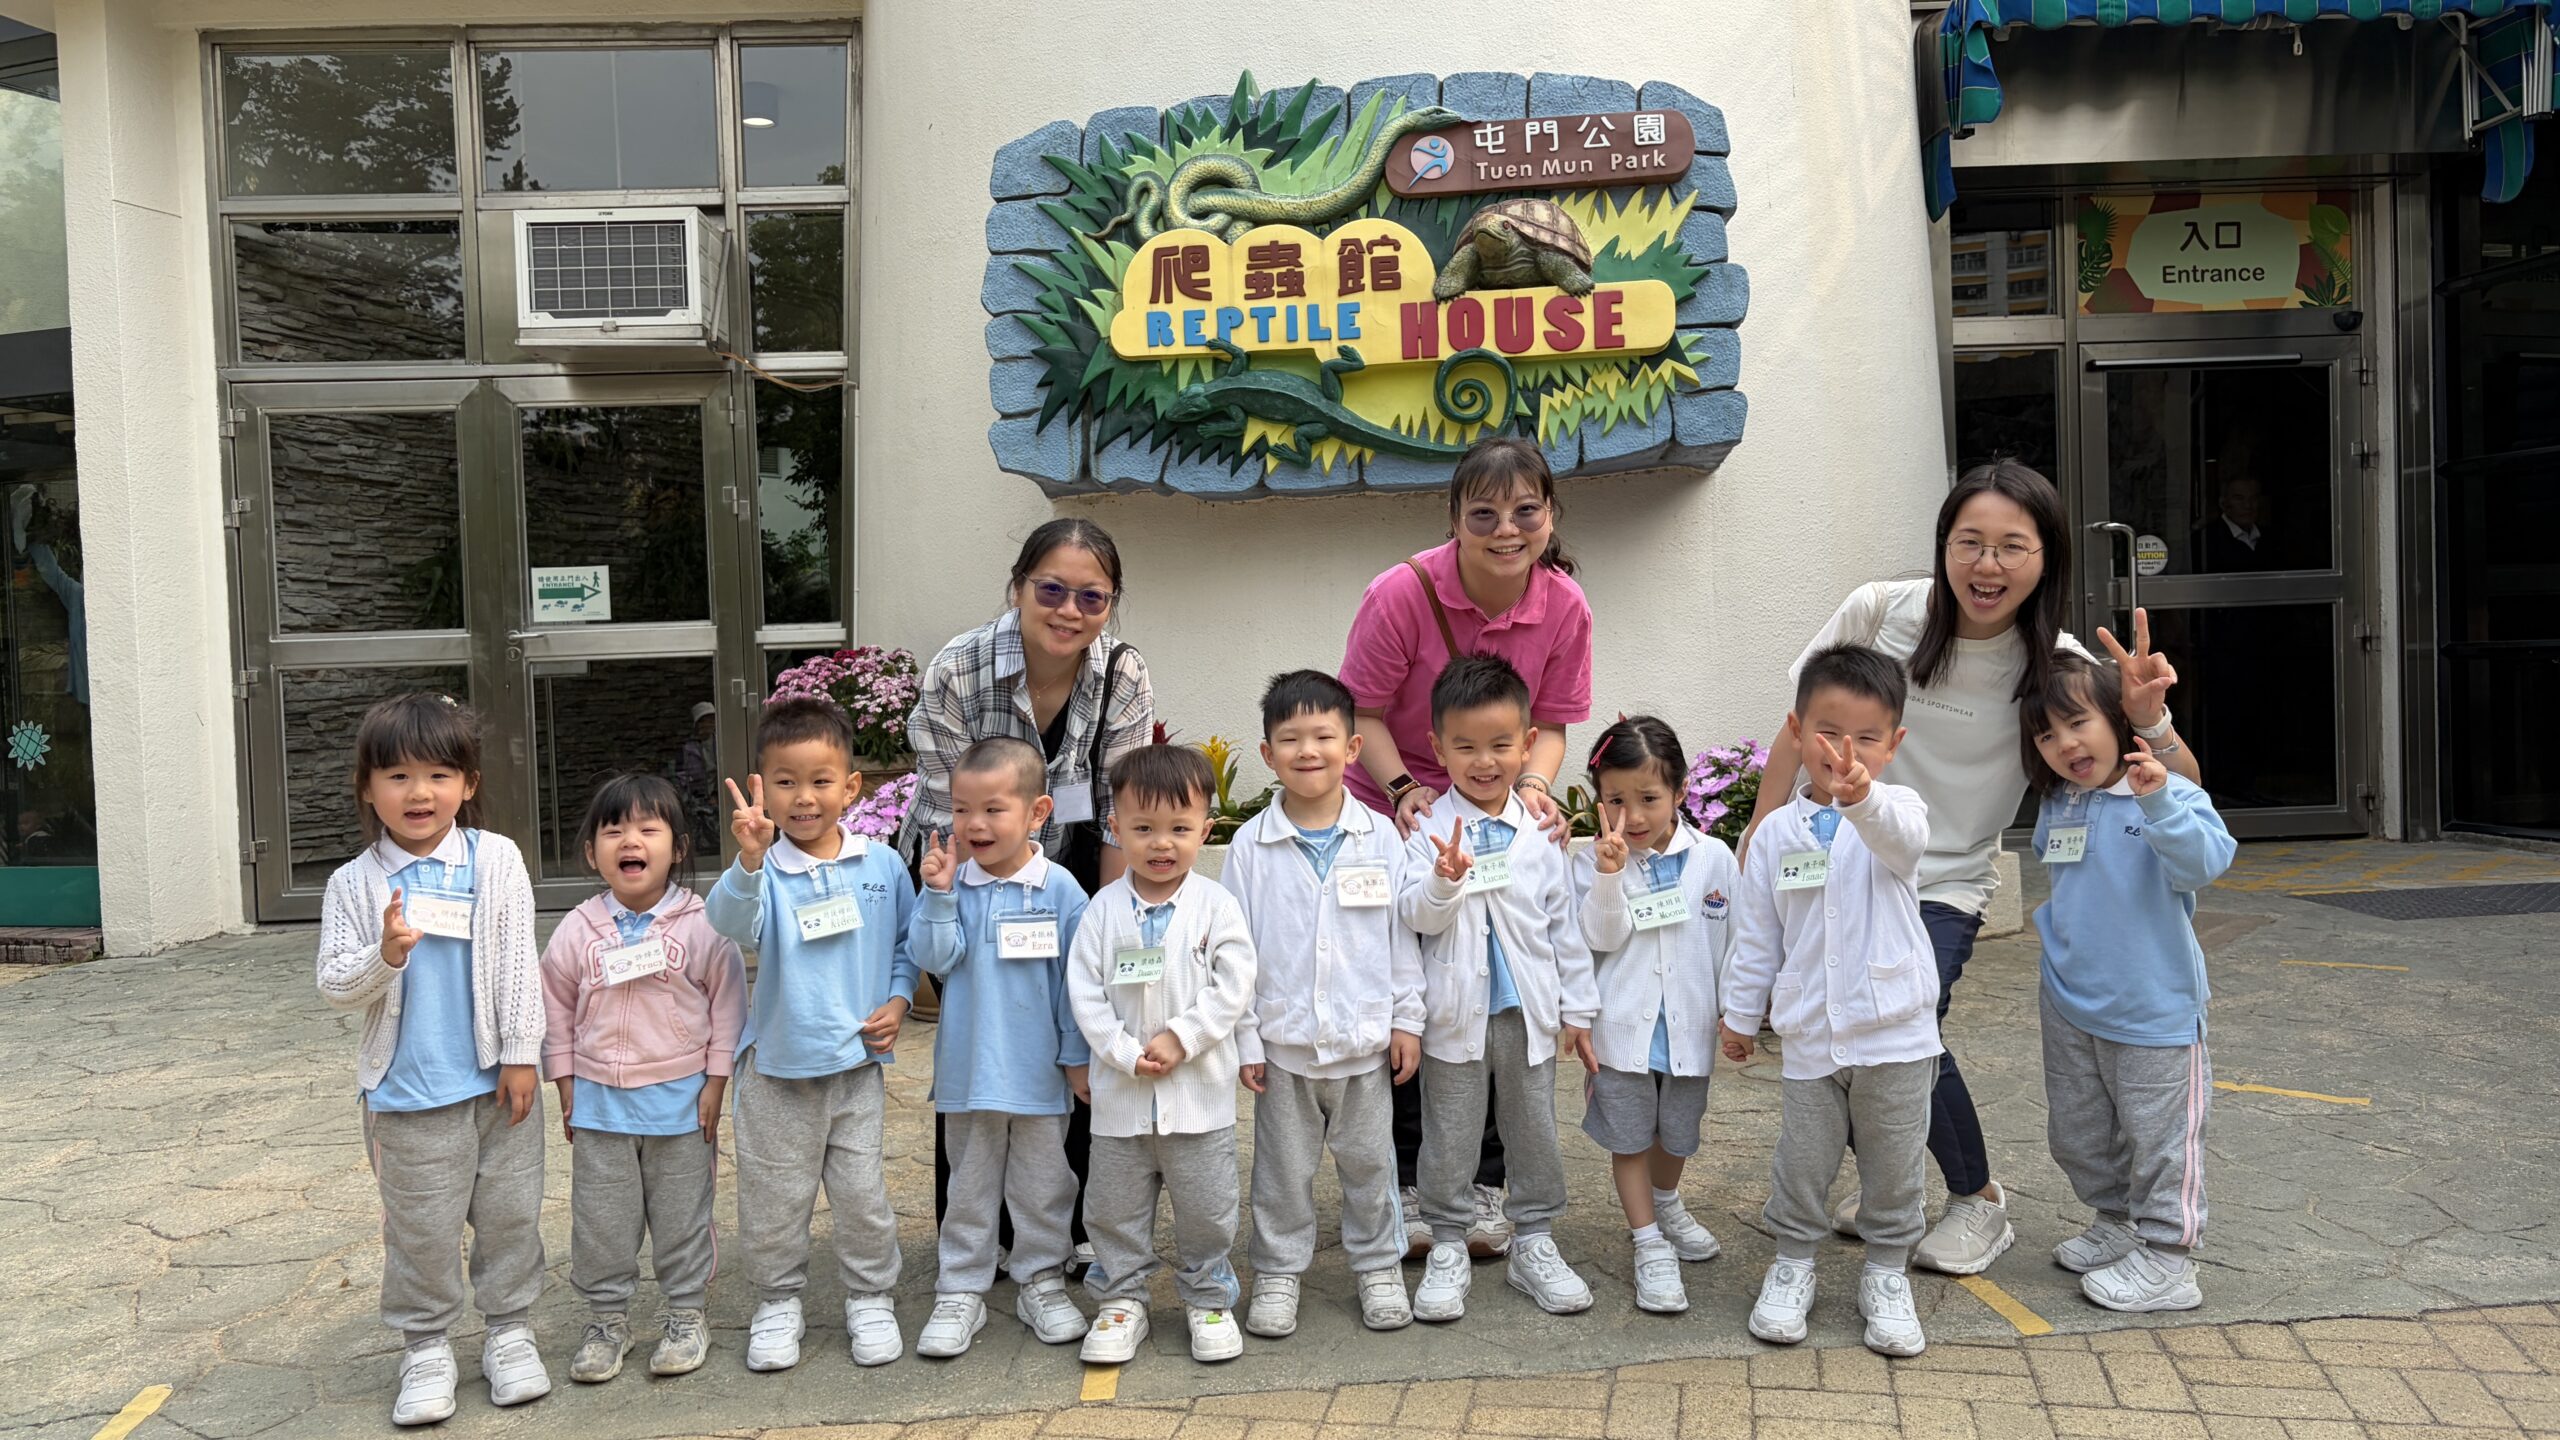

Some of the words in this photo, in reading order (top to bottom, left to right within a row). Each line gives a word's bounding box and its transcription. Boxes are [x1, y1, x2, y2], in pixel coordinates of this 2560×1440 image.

[1473, 111, 1667, 155] 屯門公園
[1476, 159, 1533, 181] Tuen
[1541, 156, 1593, 177] Mun
[1610, 149, 1667, 171] Park
[2179, 221, 2242, 252] 入口
[1150, 234, 1403, 304] 爬蟲館
[2161, 264, 2266, 286] Entrance
[1147, 301, 1362, 348] REPTILE
[1400, 290, 1625, 361] HOUSE
[2136, 551, 2165, 559] AUTION
[1926, 699, 1974, 717] SPORTSWEAR
[1482, 872, 1510, 884] Lucas
[1802, 872, 1825, 882] Isaac
[1658, 908, 1687, 920] Moona
[1032, 941, 1055, 951] Ezra
[635, 960, 664, 972] Tracy
